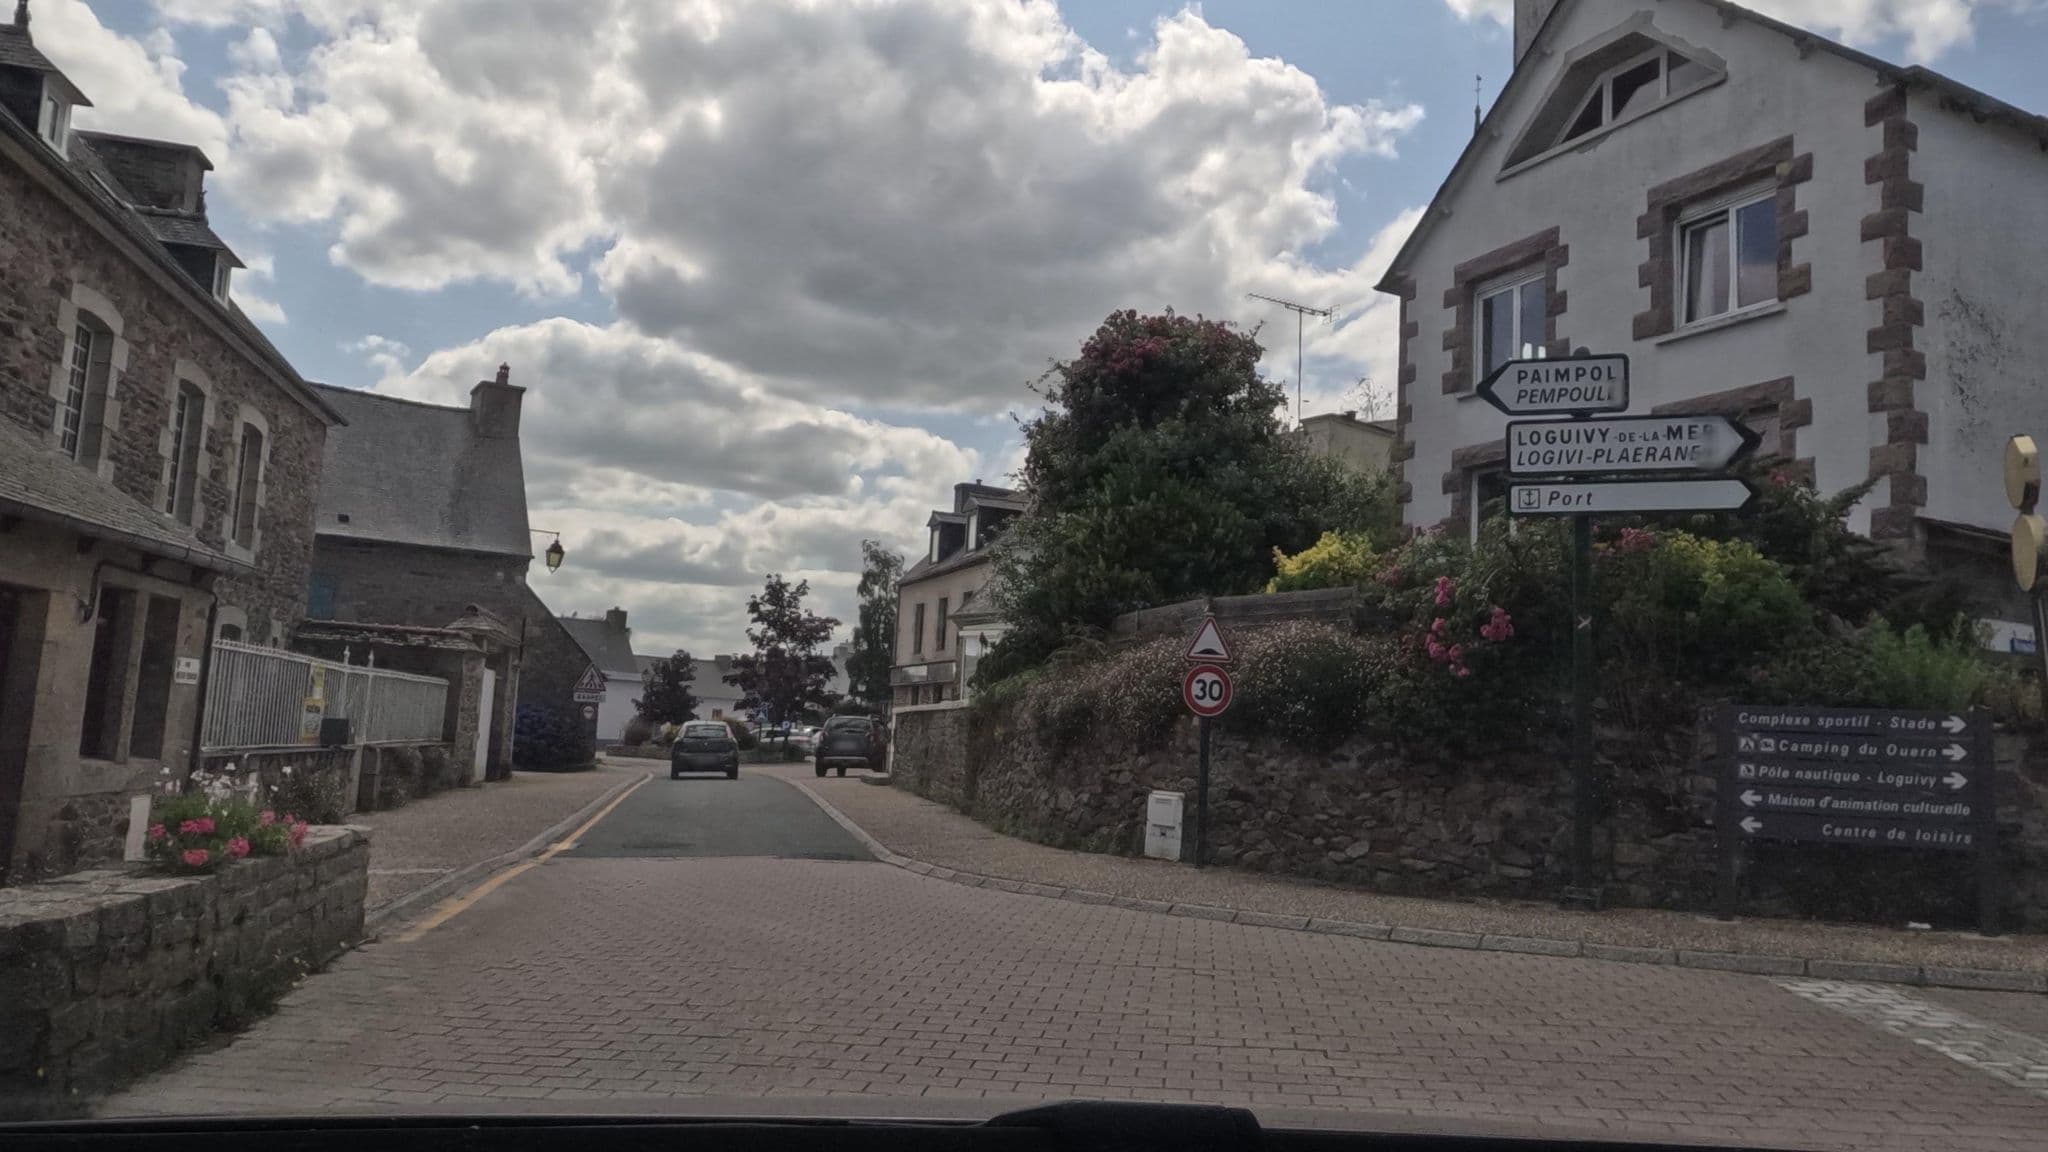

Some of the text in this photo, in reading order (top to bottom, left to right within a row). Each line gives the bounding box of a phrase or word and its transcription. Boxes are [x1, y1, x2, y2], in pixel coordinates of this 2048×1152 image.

[1517, 365, 1617, 385] PAIMPOL
[1516, 386, 1614, 404] PEMPOUL
[1516, 445, 1707, 466] LOGIVI-PLAERANE
[1547, 490, 1593, 506] Port
[1194, 678, 1223, 702] 30
[1738, 711, 1811, 727] Complexe
[1817, 713, 1870, 728] sportif
[1889, 715, 1937, 730] Stade
[1778, 739, 1850, 757] Camping
[1858, 743, 1877, 756] du
[1758, 763, 1790, 779] Pôle
[1795, 767, 1861, 784] nautique
[1877, 771, 1937, 789] Loguivy
[1767, 793, 1971, 816] Maison d'animation culturelle
[1822, 823, 1972, 845] Centre de loisirs
